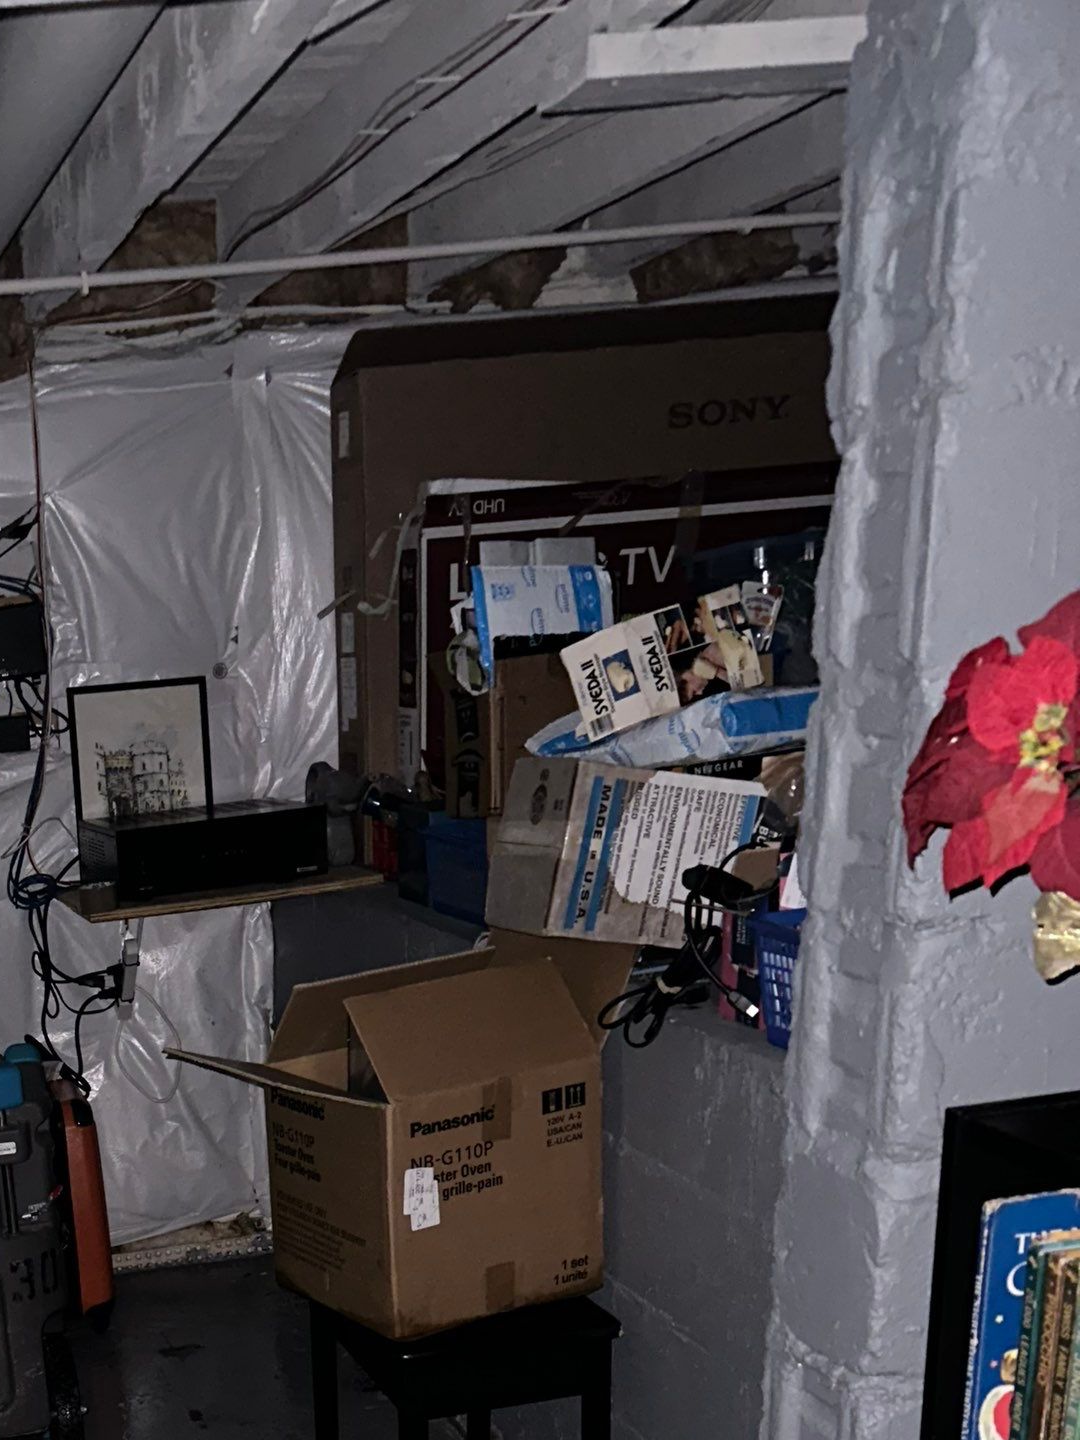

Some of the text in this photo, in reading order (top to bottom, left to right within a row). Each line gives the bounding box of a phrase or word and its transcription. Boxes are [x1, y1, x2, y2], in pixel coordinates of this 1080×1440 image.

[669, 395, 790, 428] SONY
[472, 498, 505, 515] UHD
[619, 545, 677, 586] TV
[646, 646, 669, 692] SVEDA
[585, 669, 609, 715] SVEDA
[592, 784, 612, 840] MADE
[642, 784, 660, 839] ATTRACTIVE
[694, 789, 705, 813] SAFE
[708, 791, 727, 849] ECONOMICAL
[732, 794, 747, 842] EFFECTIVE
[651, 786, 683, 905] ENVIRONMENTALLY SOUND
[573, 871, 595, 925] U.S.A.
[271, 1087, 325, 1121] Panasonic
[410, 1104, 496, 1138] Panasonic
[410, 1140, 495, 1169] NB-G110P
[433, 1160, 492, 1183] ster Oven
[442, 1173, 503, 1201] grille-pain
[553, 1273, 560, 1285] 1
[561, 1255, 589, 1270] 1 set
[1036, 1293, 1059, 1389] PINOCCHIO
[1060, 1302, 1073, 1341] SWISS
[1054, 1344, 1070, 1389] FAMILY
